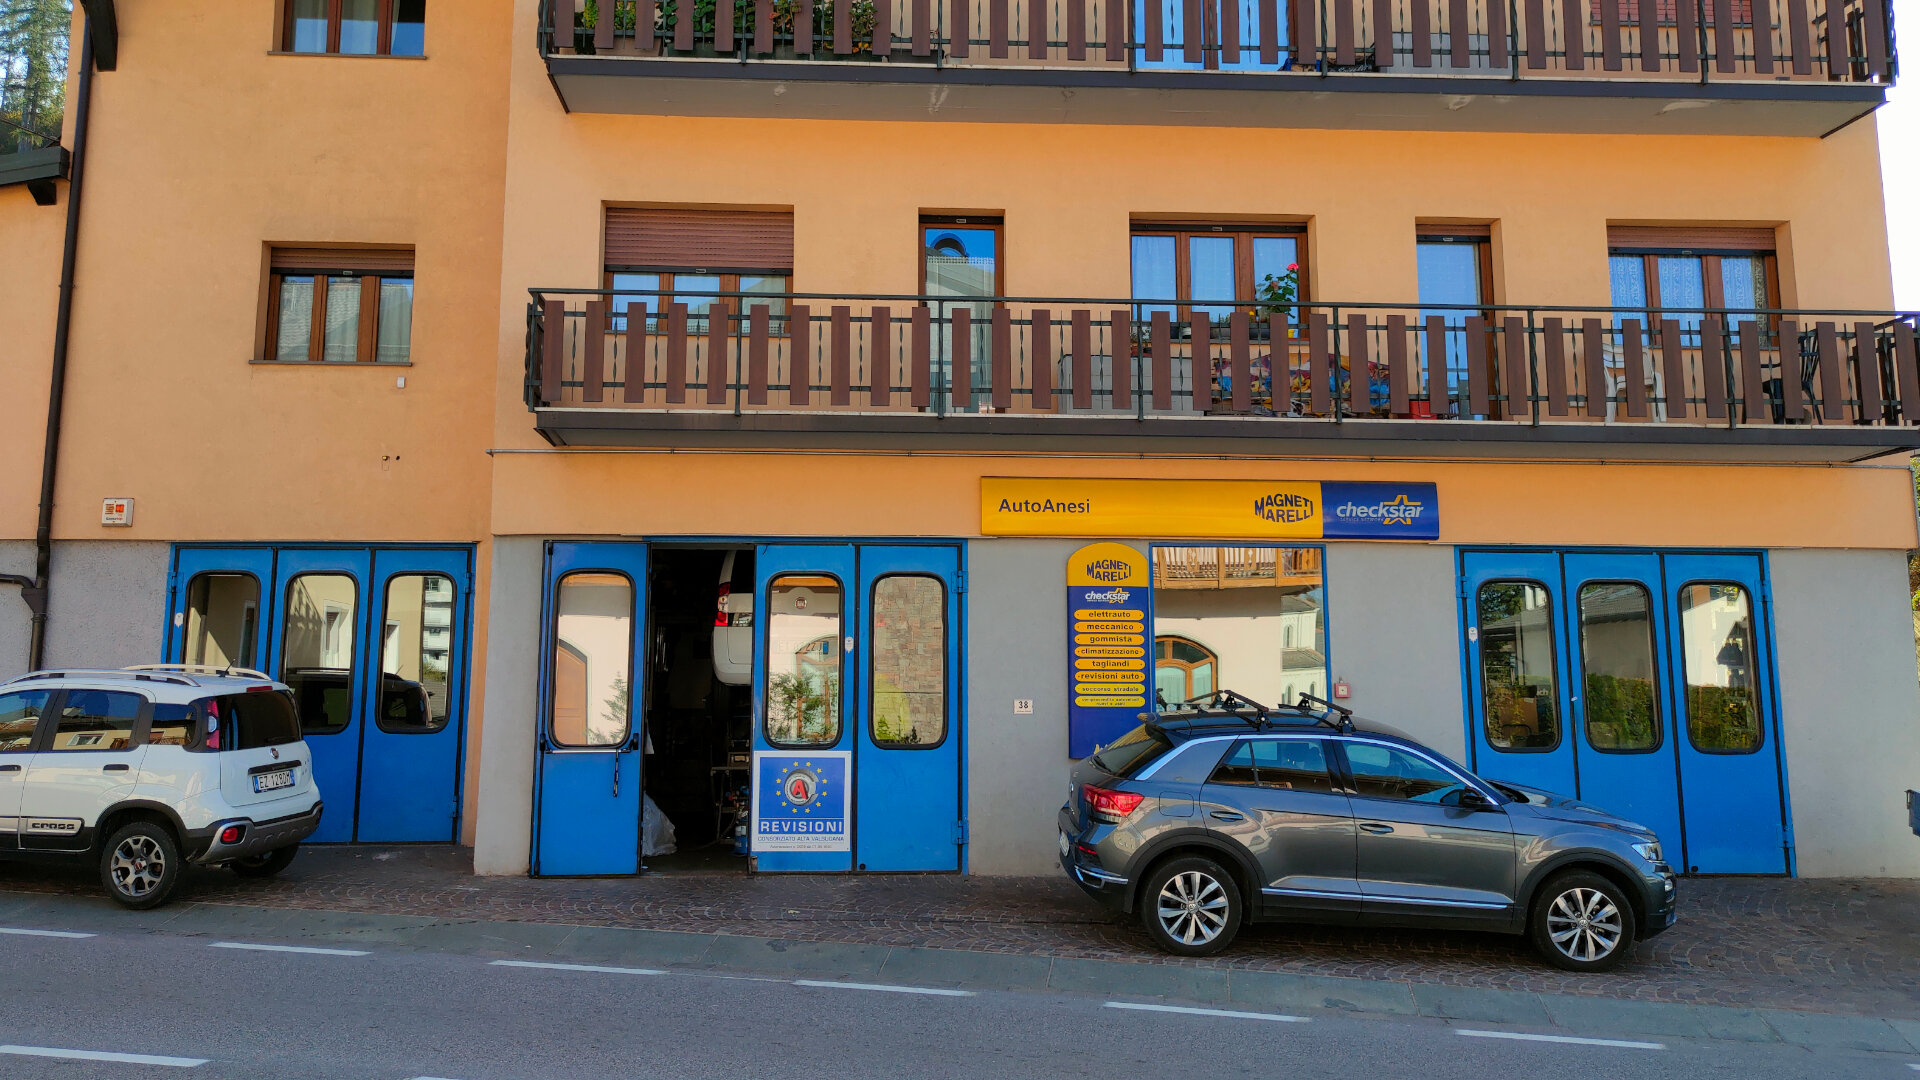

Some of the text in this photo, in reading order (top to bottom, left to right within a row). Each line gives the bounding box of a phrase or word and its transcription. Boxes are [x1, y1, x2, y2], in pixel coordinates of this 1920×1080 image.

[999, 499, 1090, 513] AutoAnesi
[1255, 494, 1314, 511] MAGNETI
[1255, 508, 1314, 523] MARELLI
[1336, 501, 1424, 518] checkstar
[1086, 560, 1131, 573] MAGNETI
[1086, 570, 1131, 581] MARELLI
[1085, 591, 1130, 601] checkstar
[1092, 660, 1130, 668] tagliandi
[1018, 700, 1029, 709] 38
[258, 775, 270, 789] EZ
[760, 820, 843, 832] REVISIONI
